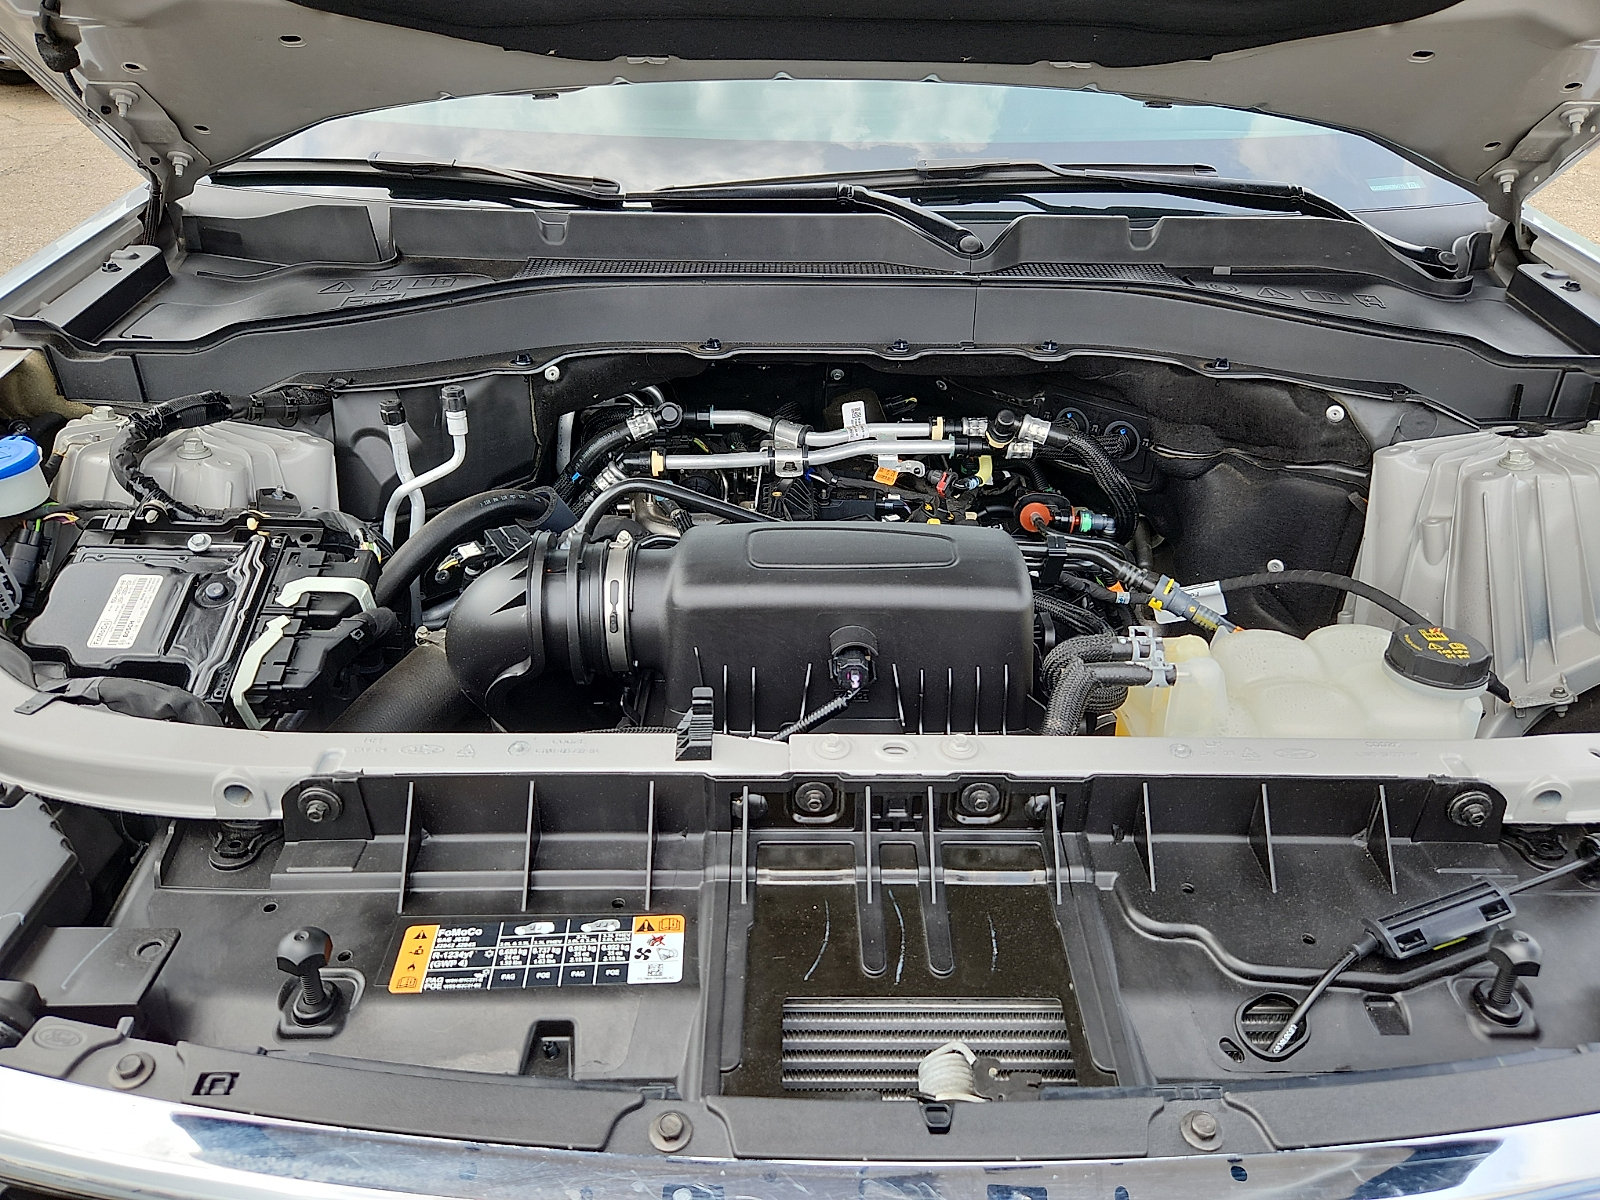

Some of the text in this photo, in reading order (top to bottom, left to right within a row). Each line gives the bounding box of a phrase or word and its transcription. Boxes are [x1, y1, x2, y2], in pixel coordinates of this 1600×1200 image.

[122, 620, 134, 638] BOSCH
[438, 927, 483, 937] FoMoCo
[432, 950, 474, 959] R-1234yf
[430, 960, 457, 969] (GWP
